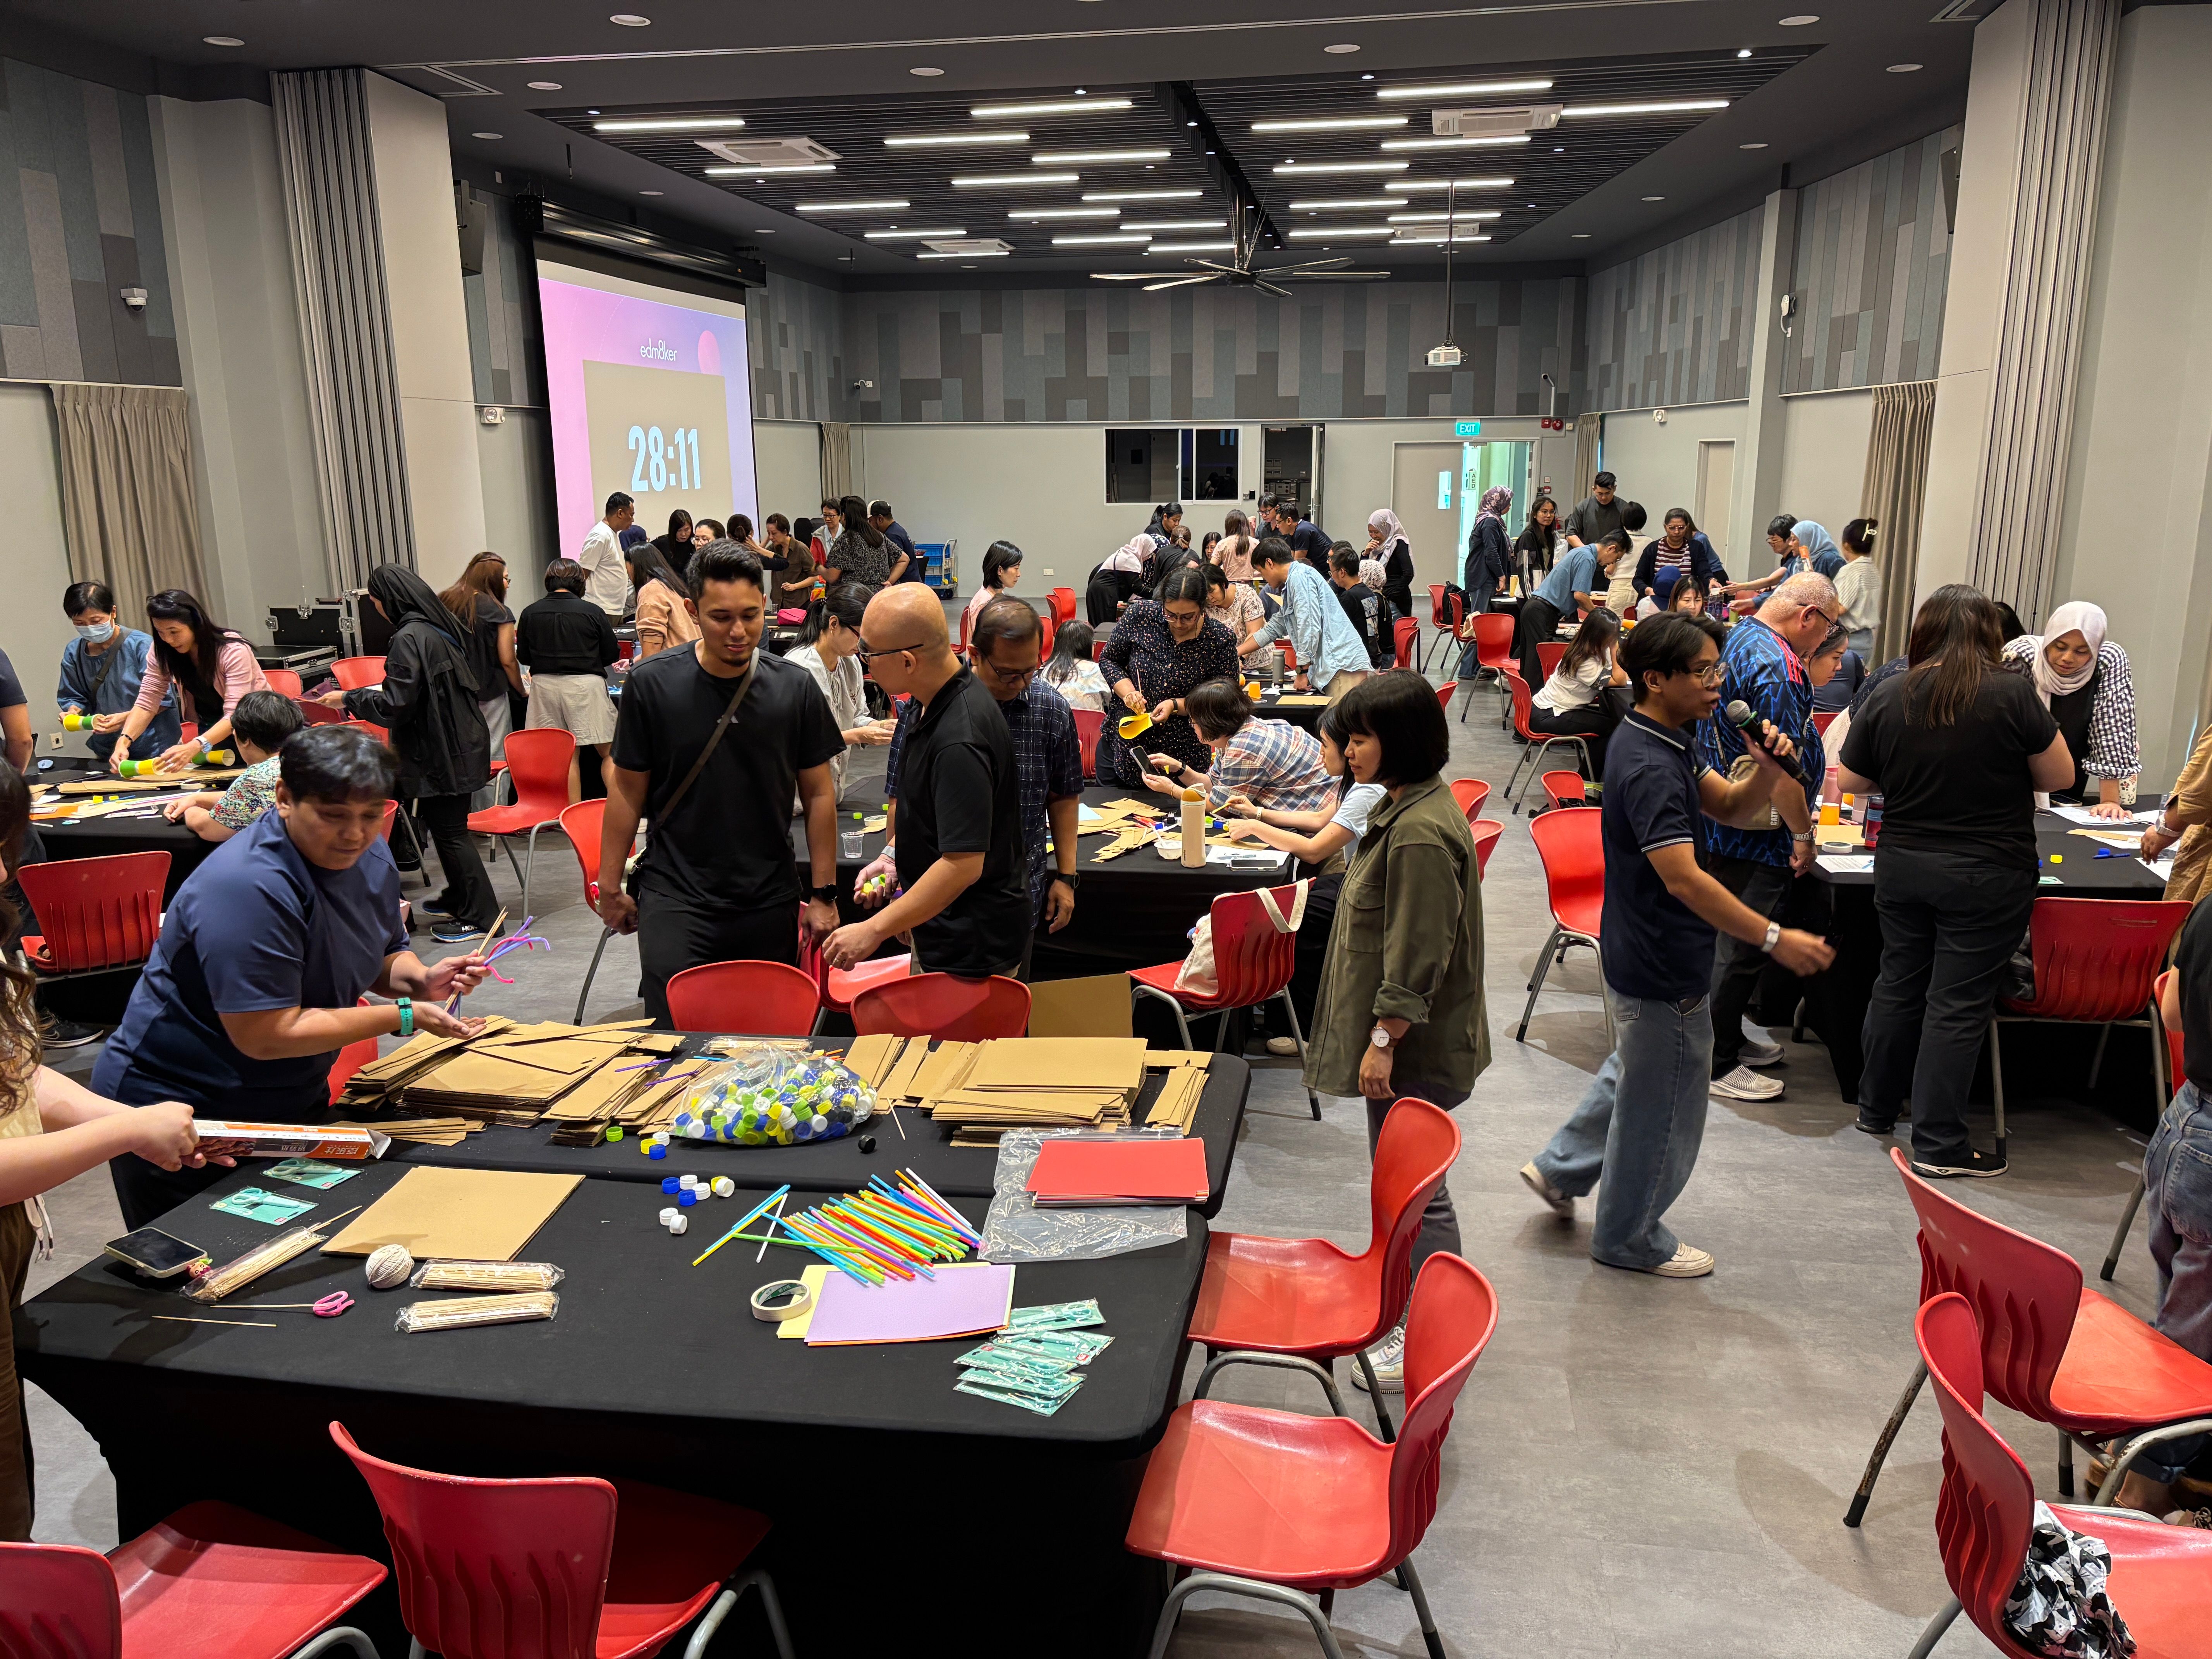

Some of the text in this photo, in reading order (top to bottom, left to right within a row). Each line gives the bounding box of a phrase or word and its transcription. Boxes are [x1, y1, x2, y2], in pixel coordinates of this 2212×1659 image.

[1460, 424, 1475, 433] EXIT
[628, 425, 701, 492] 28:11
[1770, 805, 1778, 826] CATER
